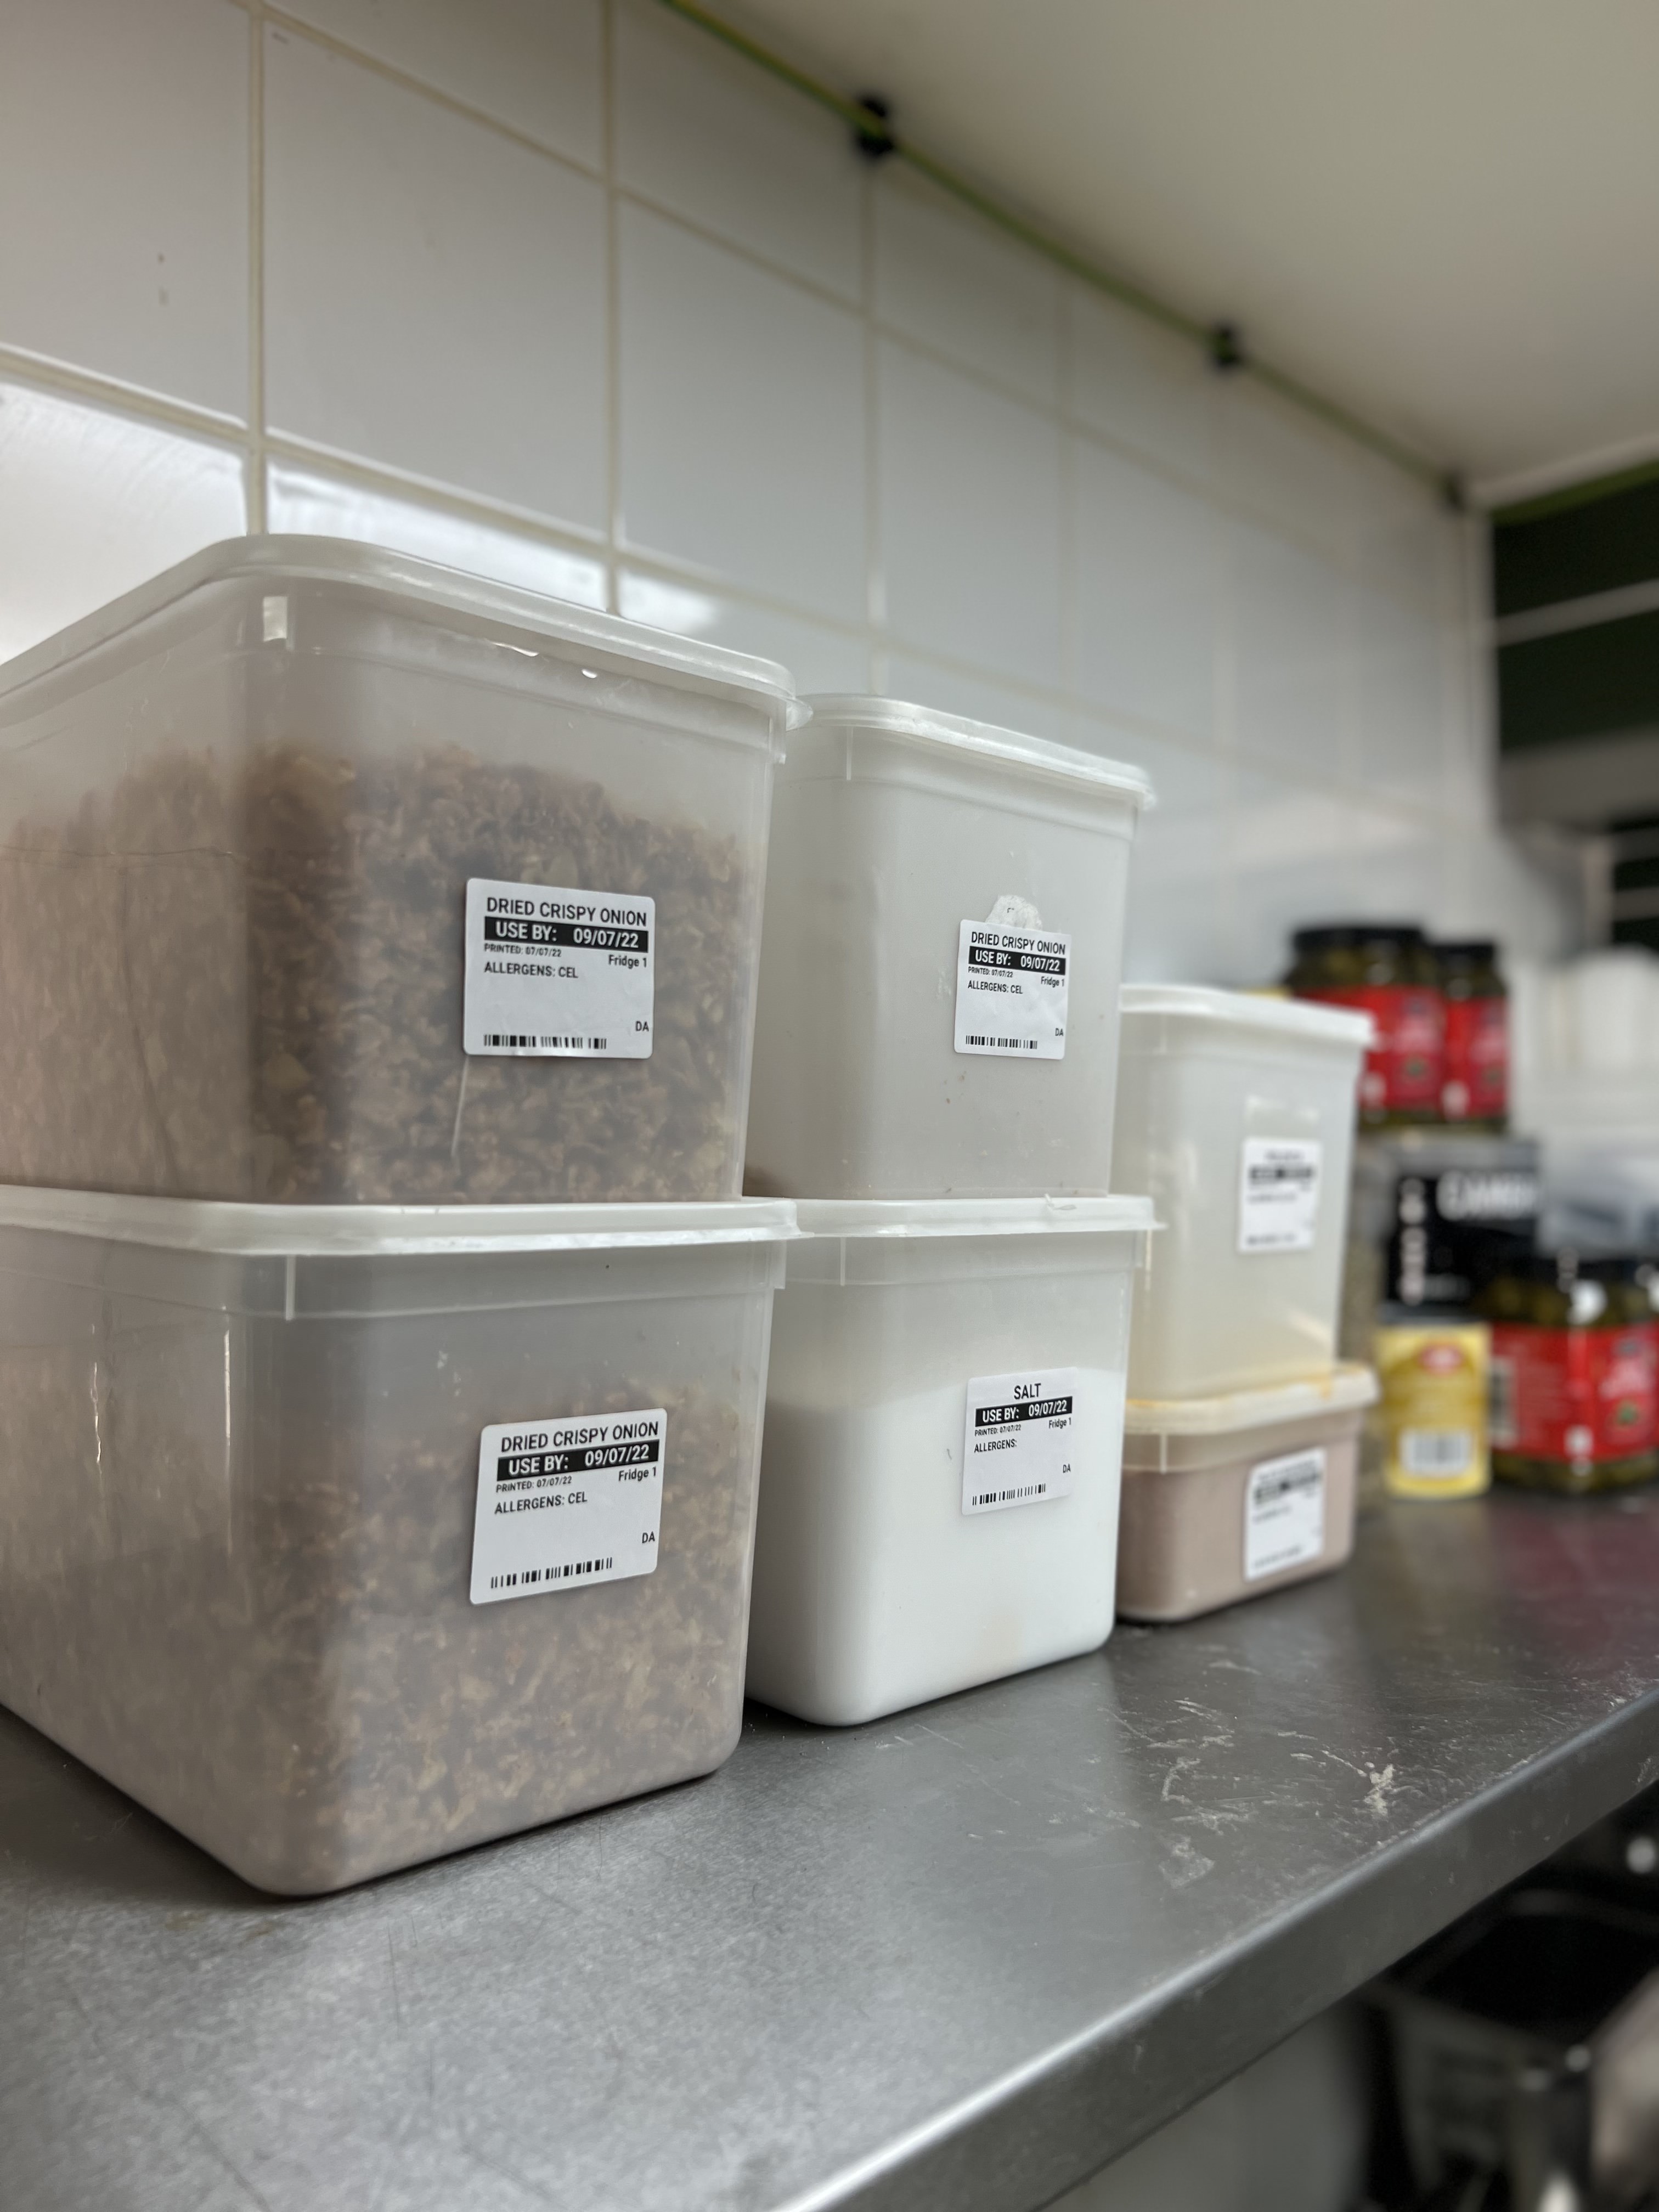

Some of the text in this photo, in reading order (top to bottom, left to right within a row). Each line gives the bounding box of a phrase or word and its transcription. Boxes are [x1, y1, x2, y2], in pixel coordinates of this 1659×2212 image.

[487, 897, 646, 926] DRIED CRISPY ONION
[495, 921, 639, 948] USE BY: 09/07/22
[484, 944, 562, 957] PRINTED: 07/07/22
[971, 932, 1065, 955] DRIED CRISPY ONION
[608, 955, 647, 969] Fridge 1
[975, 950, 1060, 972] USE BY: 09/07/22
[484, 962, 578, 978] ALLERGENS: CEL
[968, 967, 1013, 978] PRINTED: 07/07/22
[968, 980, 1023, 994] ALLERGENS: CEL
[1041, 976, 1064, 988] Fridge 1
[636, 1021, 649, 1031] DA
[1055, 1028, 1064, 1037] DA
[1014, 1383, 1041, 1400] SALT
[983, 1400, 1067, 1423] USE BY: 09/07/22
[1048, 1417, 1071, 1429] Fridge 1
[501, 1421, 658, 1453] DRIED CRISPY ONION
[974, 1427, 998, 1436] PRINTED:
[974, 1438, 1017, 1453] ALLERGENS:
[508, 1444, 649, 1476] USE BY: 09/07/22
[618, 1467, 657, 1483] Fridge 1
[1063, 1464, 1071, 1473] DA
[496, 1476, 572, 1493] PRINTED: 07/07/22
[494, 1492, 588, 1515] ALLERGENS: CEL
[642, 1531, 655, 1544] DA
